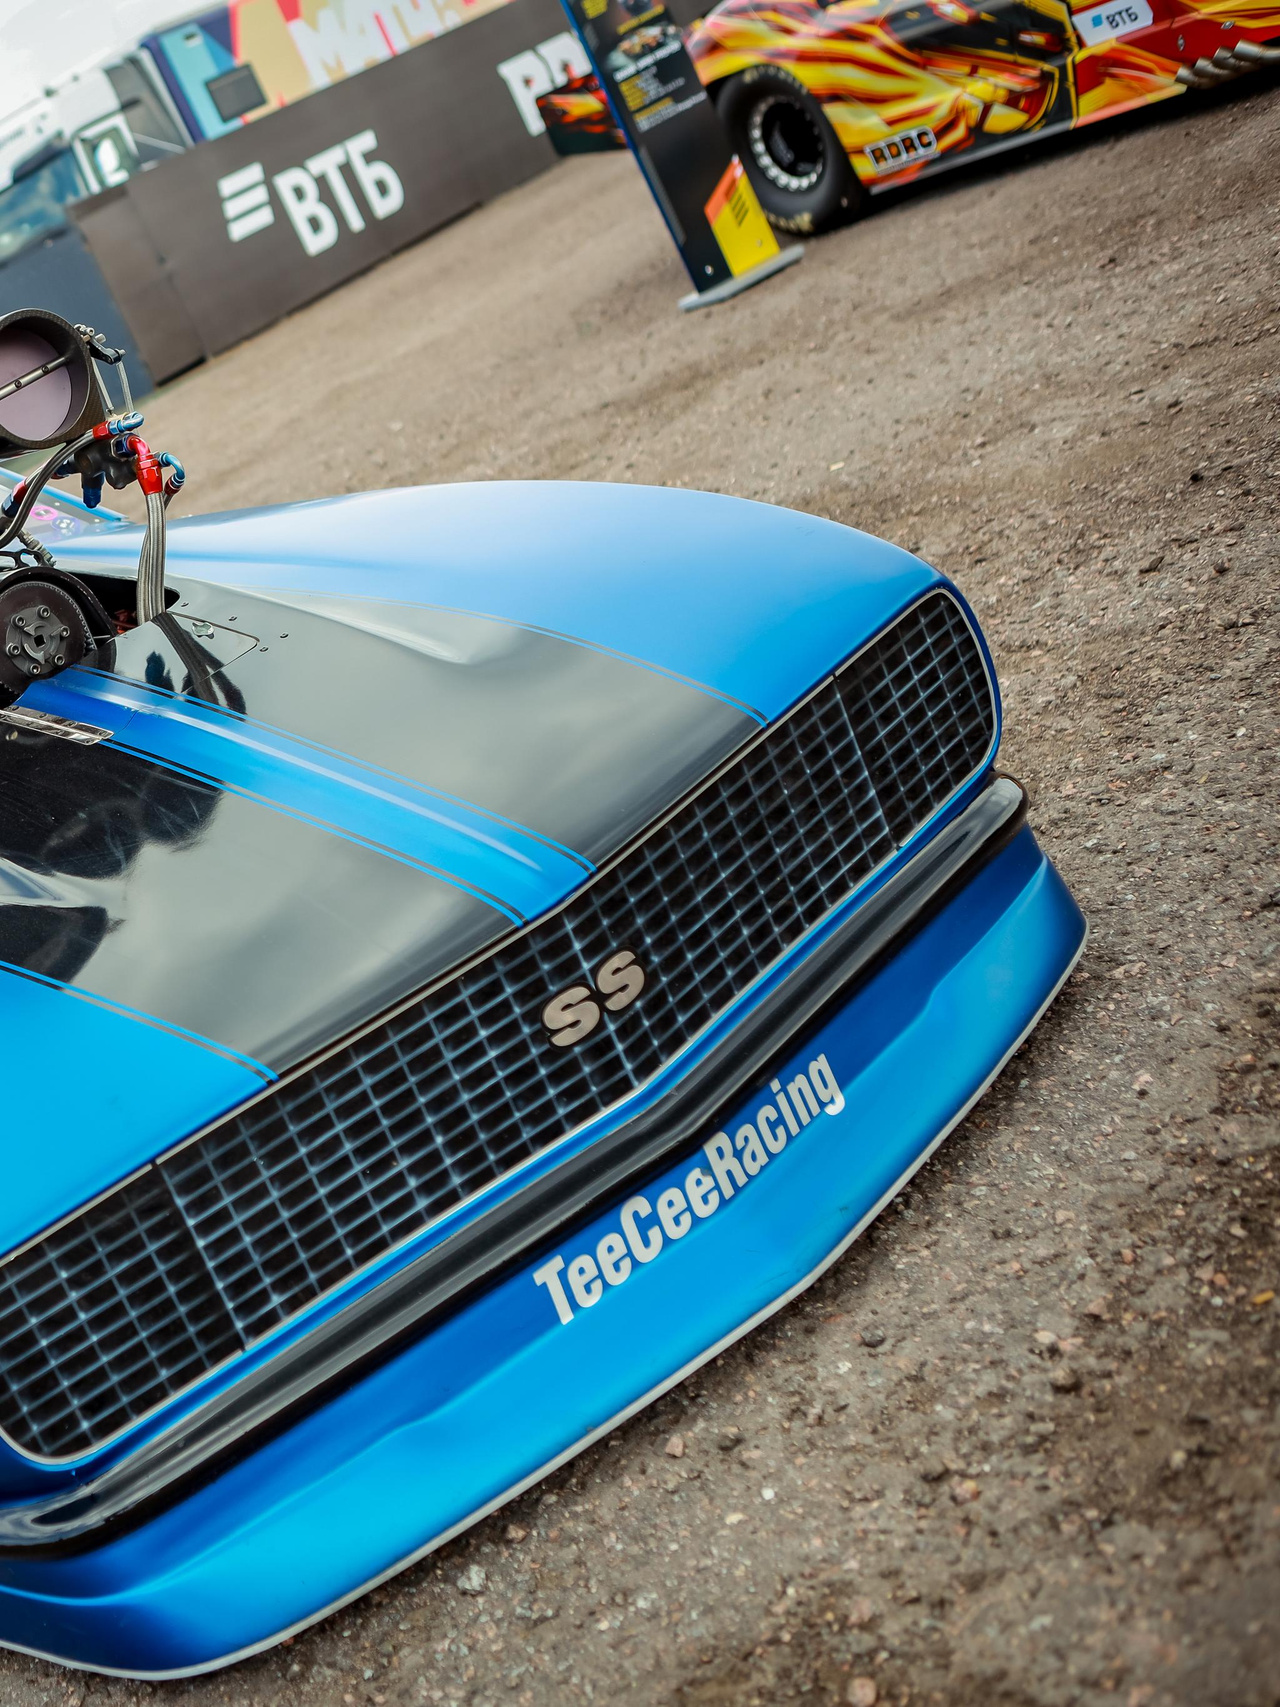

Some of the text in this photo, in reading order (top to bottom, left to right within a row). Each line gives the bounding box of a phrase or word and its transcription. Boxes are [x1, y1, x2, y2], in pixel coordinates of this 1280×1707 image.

[1106, 6, 1138, 29] ВТБ
[271, 128, 405, 258] ВТБ
[867, 128, 935, 169] RDRC
[543, 950, 645, 1047] SS
[533, 1053, 846, 1326] TeeCeeRacing
